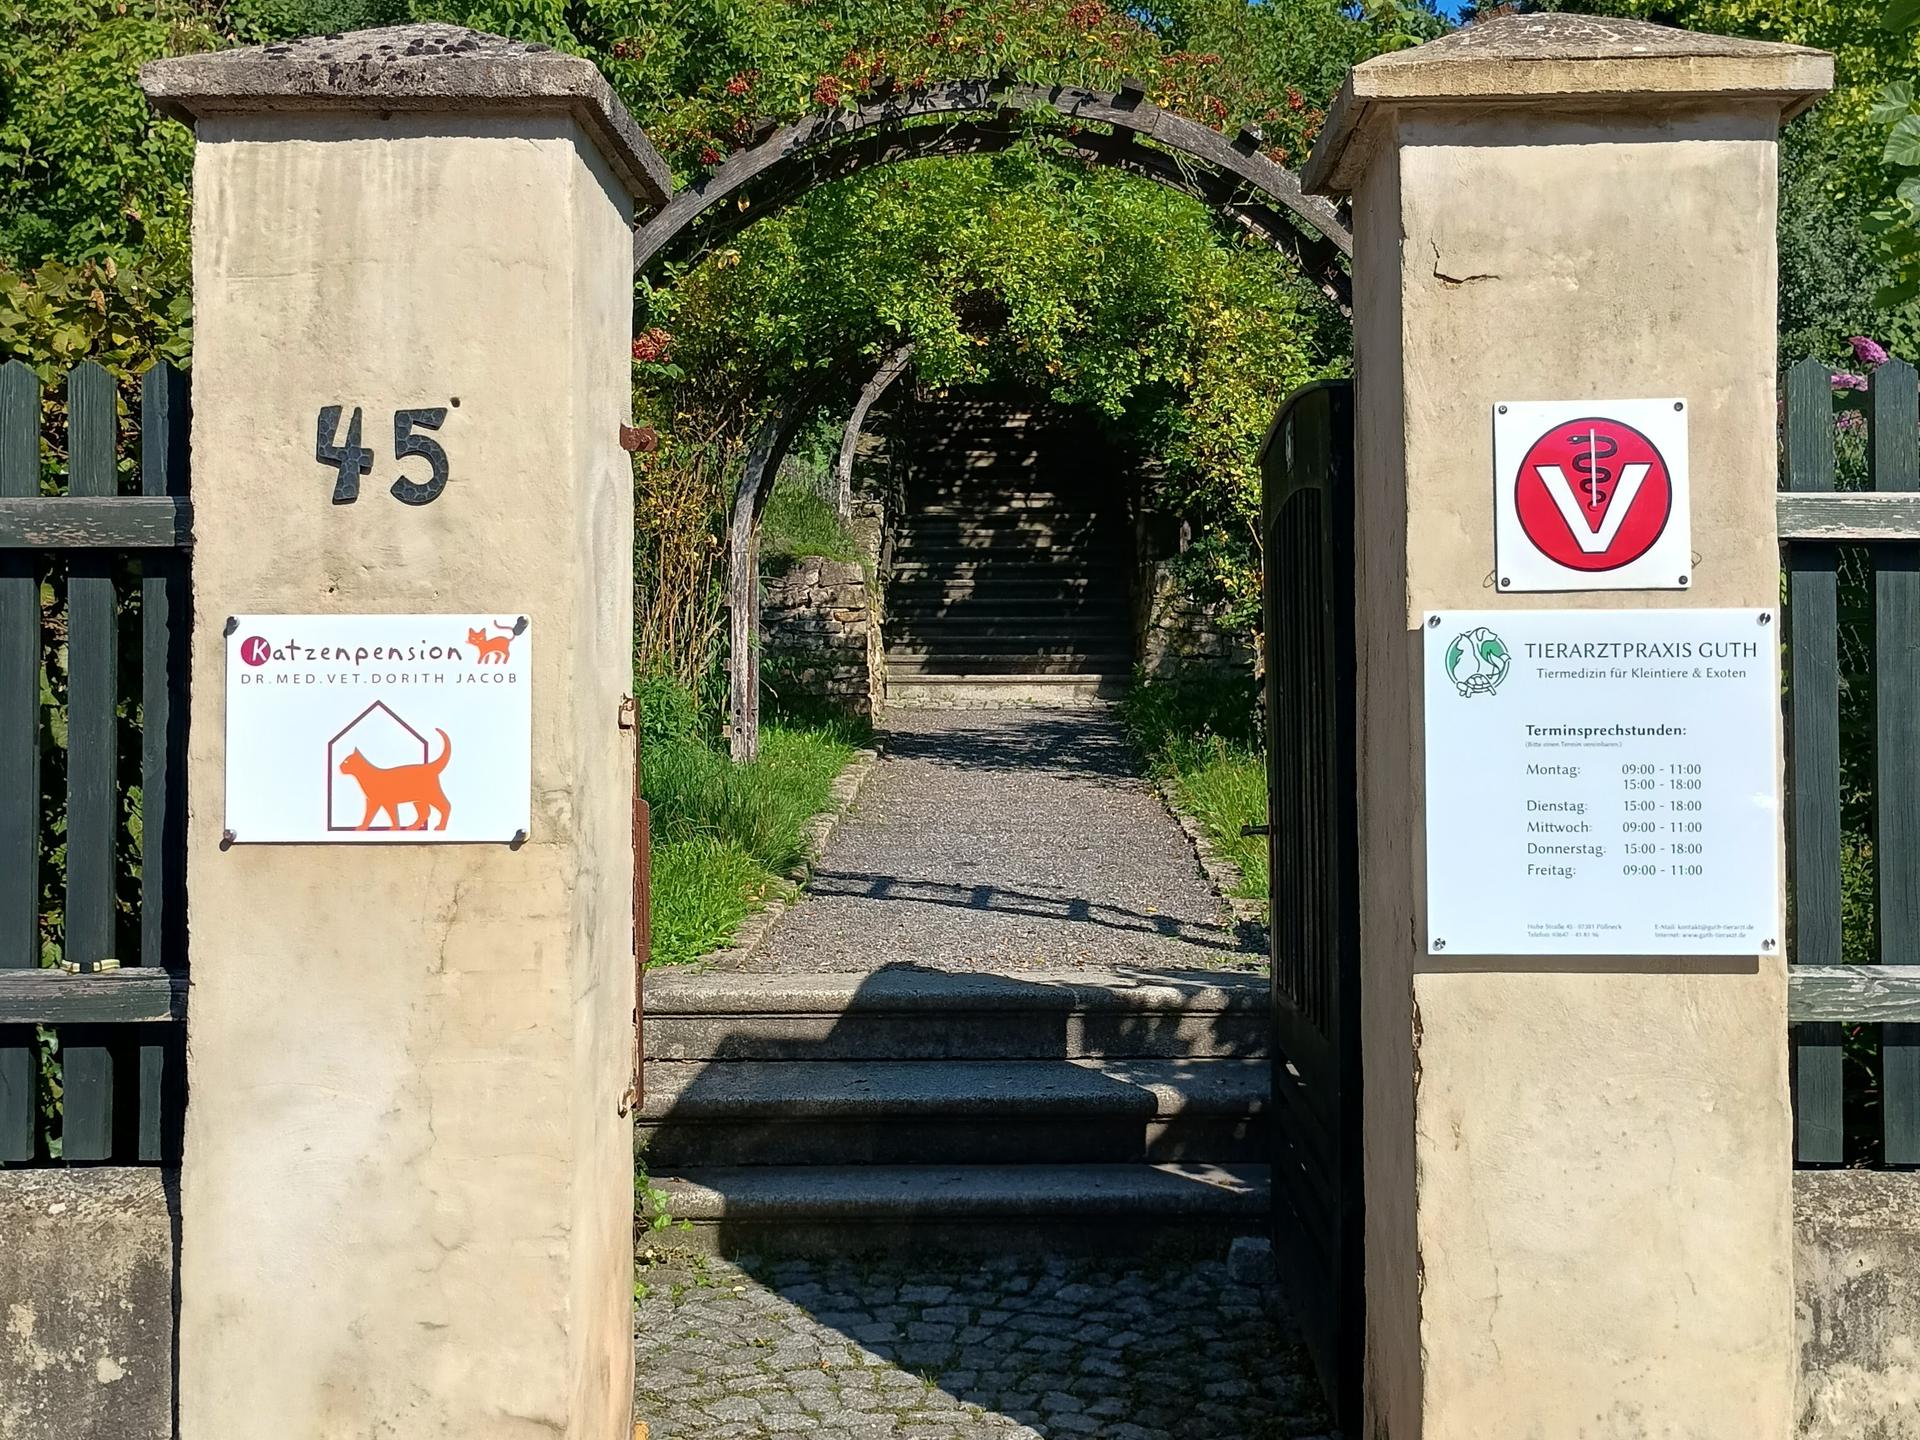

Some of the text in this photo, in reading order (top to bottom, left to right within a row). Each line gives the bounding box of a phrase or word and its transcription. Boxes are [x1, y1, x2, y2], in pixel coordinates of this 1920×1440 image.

[316, 404, 450, 506] 45
[1534, 462, 1653, 554] V
[249, 637, 462, 667] Katzenpension
[1524, 642, 1757, 659] TIERARZTPRAXIS GUTH
[456, 673, 516, 683] JACOB
[1536, 667, 1746, 680] Tiermedizin für Kleintiere & Exoten
[1525, 724, 1686, 739] Terminsprechstunden:
[1526, 764, 1580, 778] Montag:
[1622, 763, 1655, 775] 09:00
[1670, 763, 1701, 775] 11:00
[1624, 779, 1655, 790] 15:00
[1670, 778, 1701, 790] 18:00
[1527, 800, 1588, 815] Dienstag:
[1624, 800, 1655, 811] 15:00
[1670, 800, 1702, 811] 18:00
[1527, 821, 1592, 833] Mittwoch:
[1623, 821, 1655, 832] 09:00
[1670, 821, 1702, 832] 11:00
[1624, 843, 1656, 854] 15:00
[1670, 843, 1702, 855] 18:00
[1528, 864, 1576, 879] Freitag:
[1623, 864, 1656, 876] 09:00
[1672, 865, 1702, 876] 11:00
